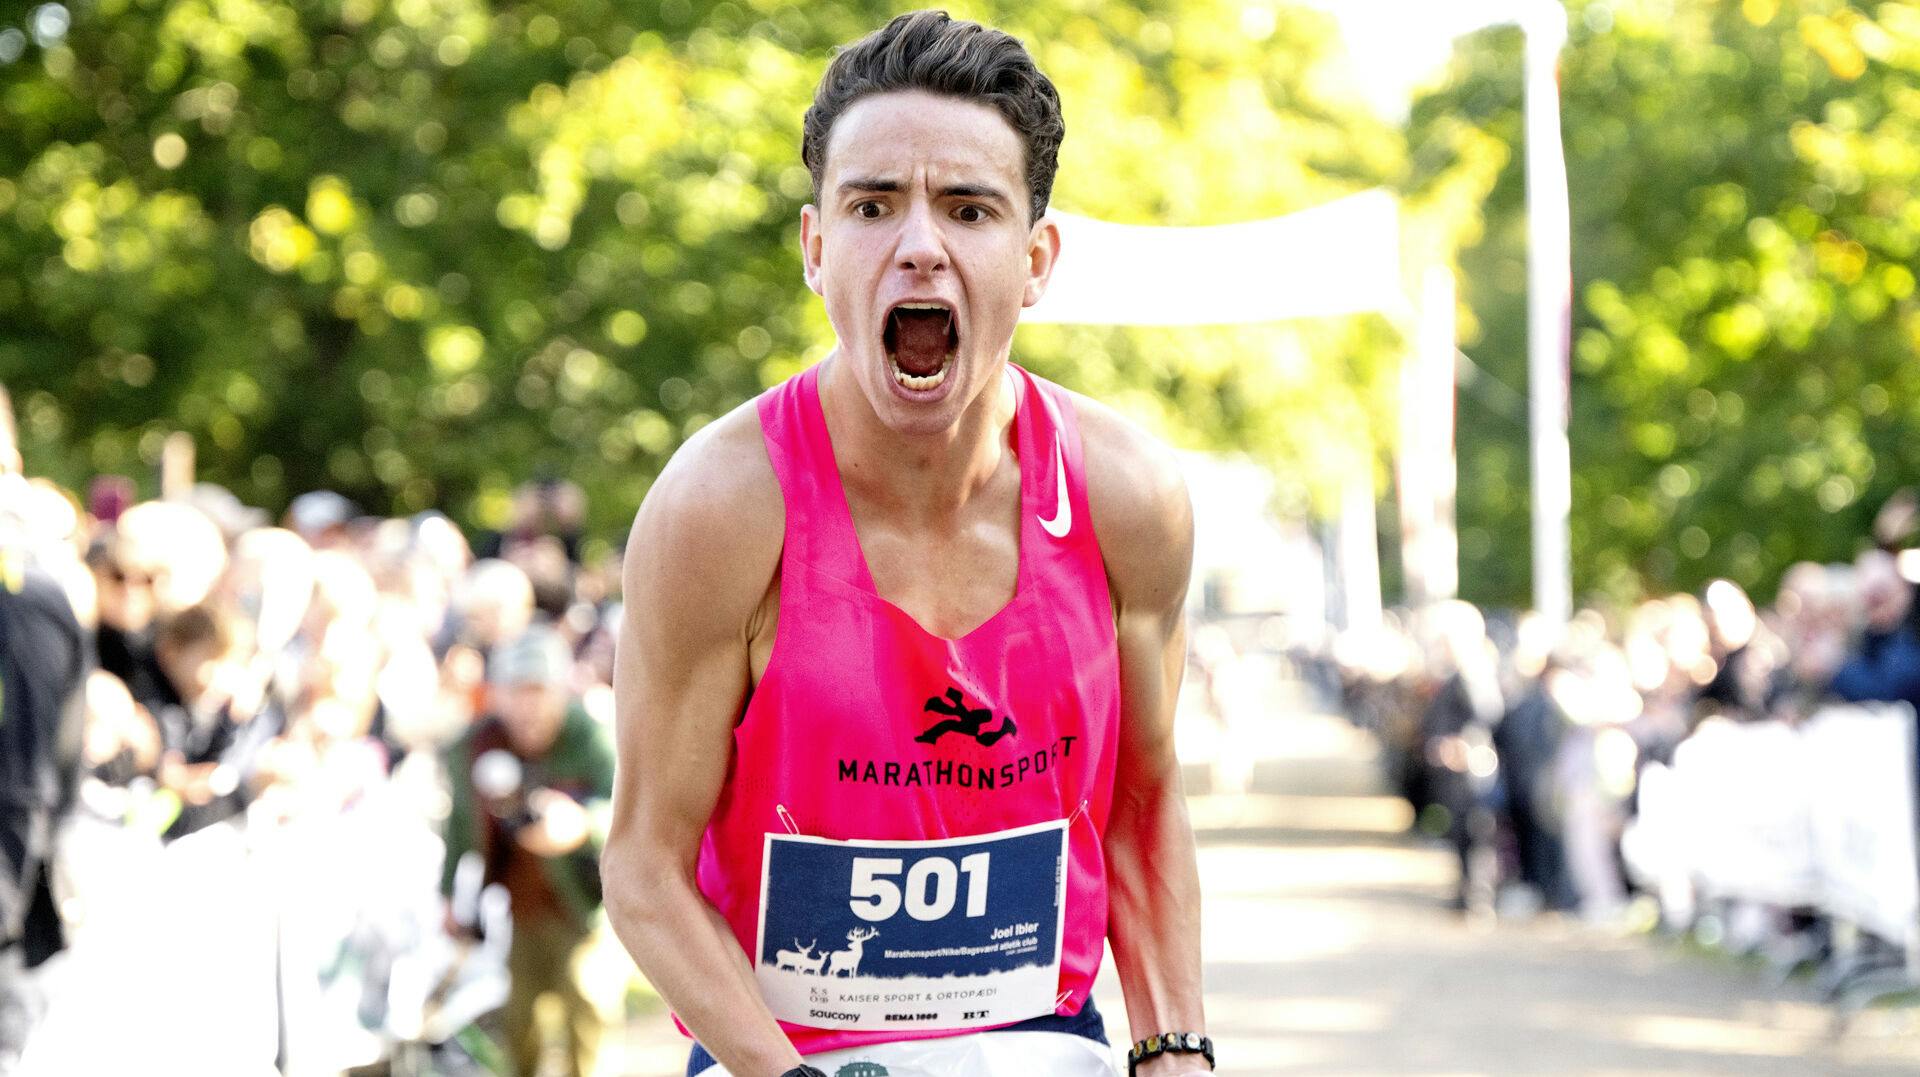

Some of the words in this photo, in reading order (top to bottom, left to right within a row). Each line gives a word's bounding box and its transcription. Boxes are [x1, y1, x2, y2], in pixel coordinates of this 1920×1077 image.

[849, 852, 990, 922] 501
[990, 925, 1014, 940] Joel
[839, 993, 880, 1003] KAISER
[884, 993, 920, 1003] SPORT
[925, 993, 932, 1001] &
[936, 988, 997, 1000] ORTOPÆDI
[809, 1009, 860, 1023] saucony
